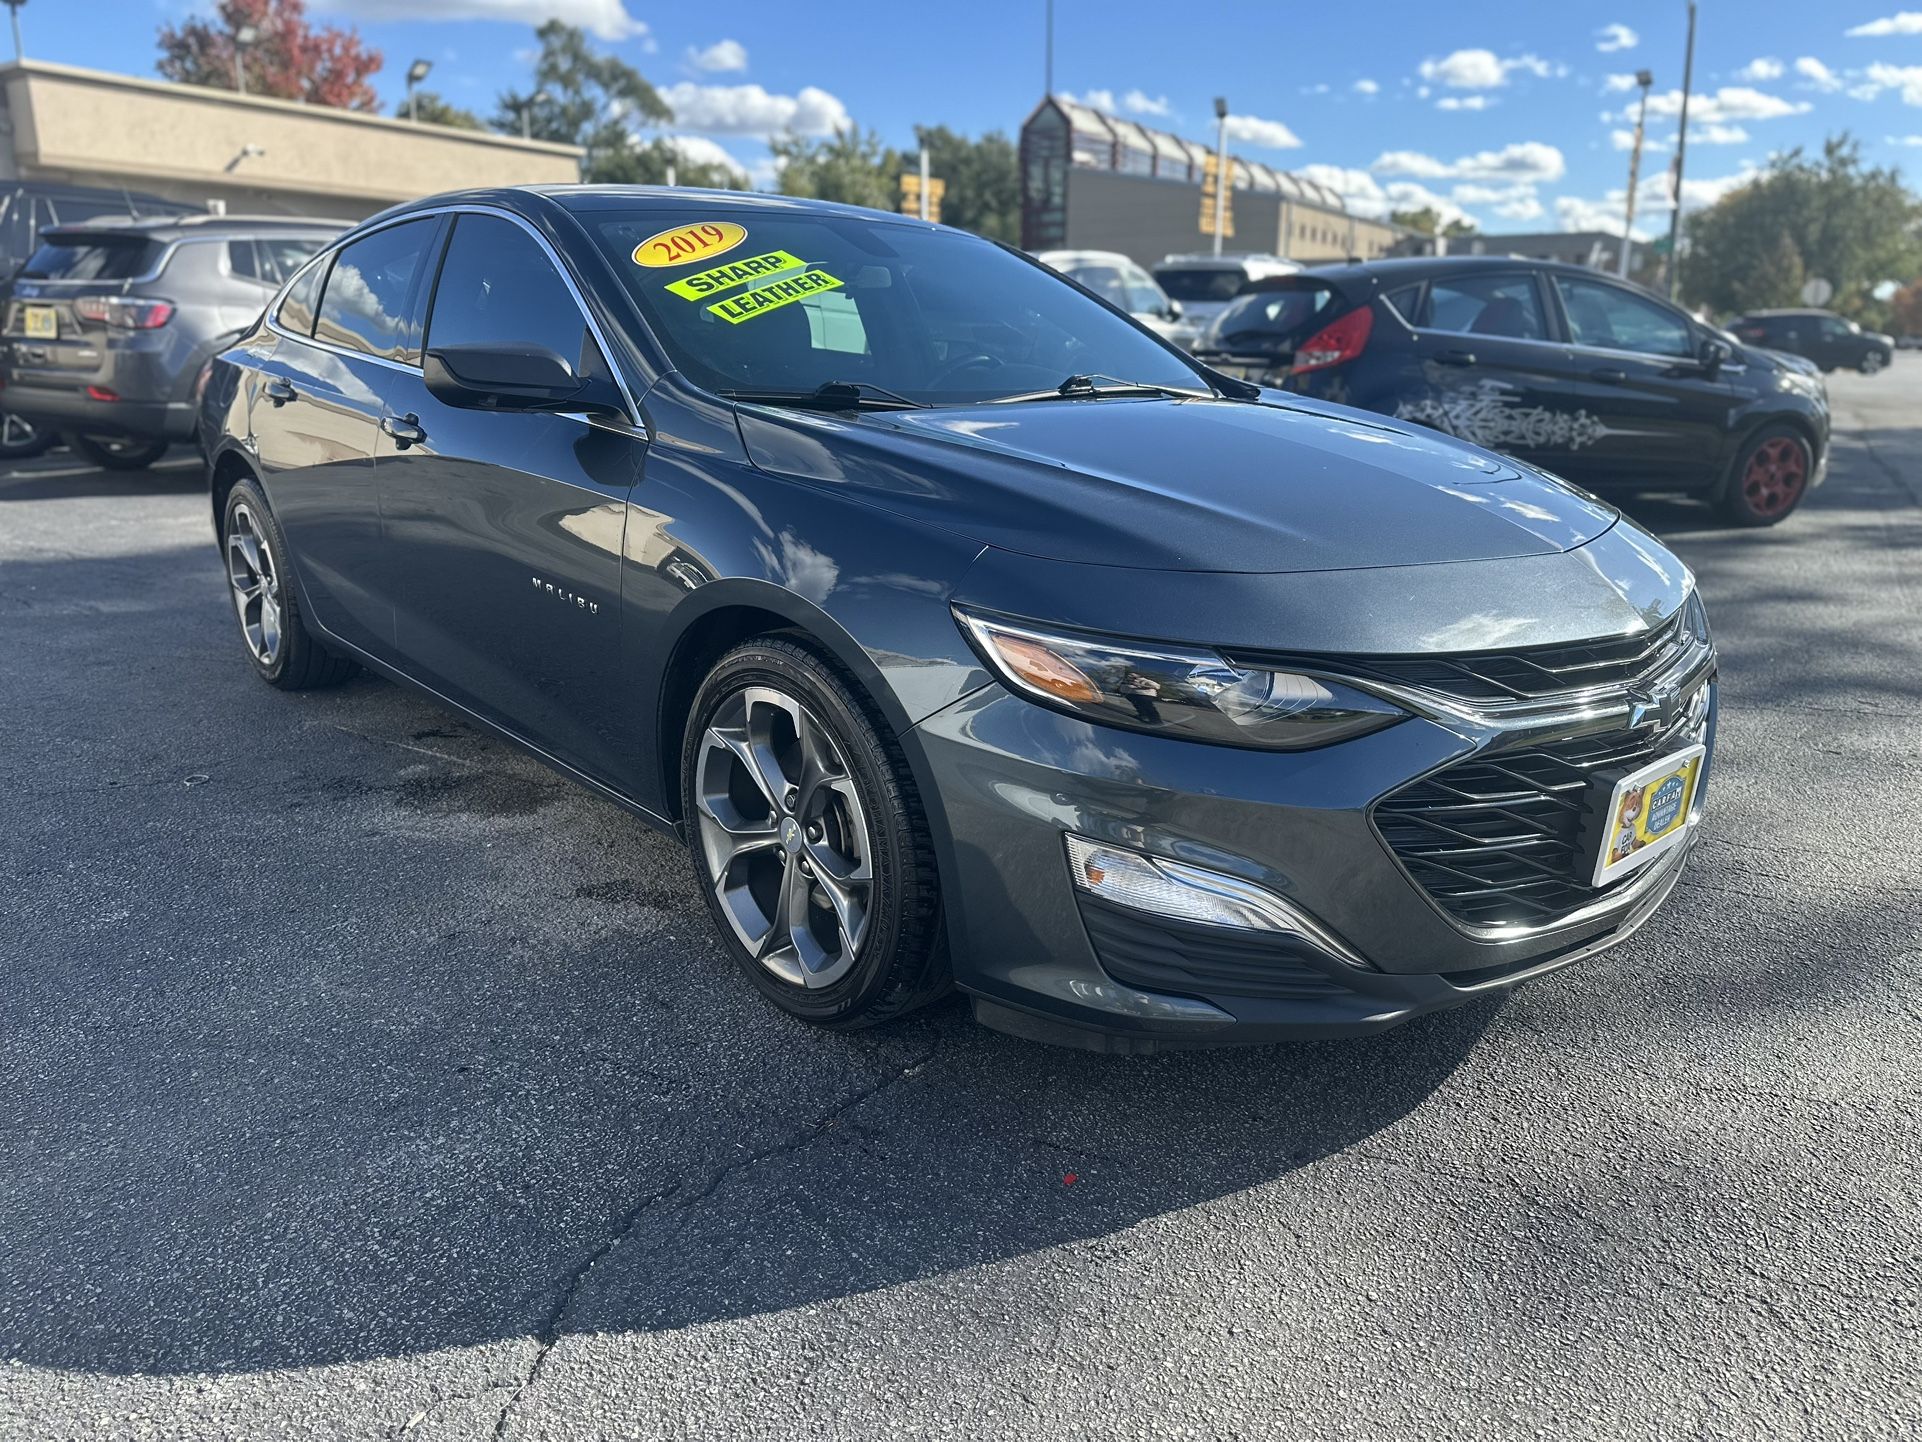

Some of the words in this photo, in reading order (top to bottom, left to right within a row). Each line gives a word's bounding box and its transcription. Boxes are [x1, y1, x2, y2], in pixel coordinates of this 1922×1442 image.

[653, 224, 724, 262] 2019
[685, 255, 785, 293] SHARP
[718, 272, 829, 319] LEATHER
[532, 577, 598, 614] MALIBU
